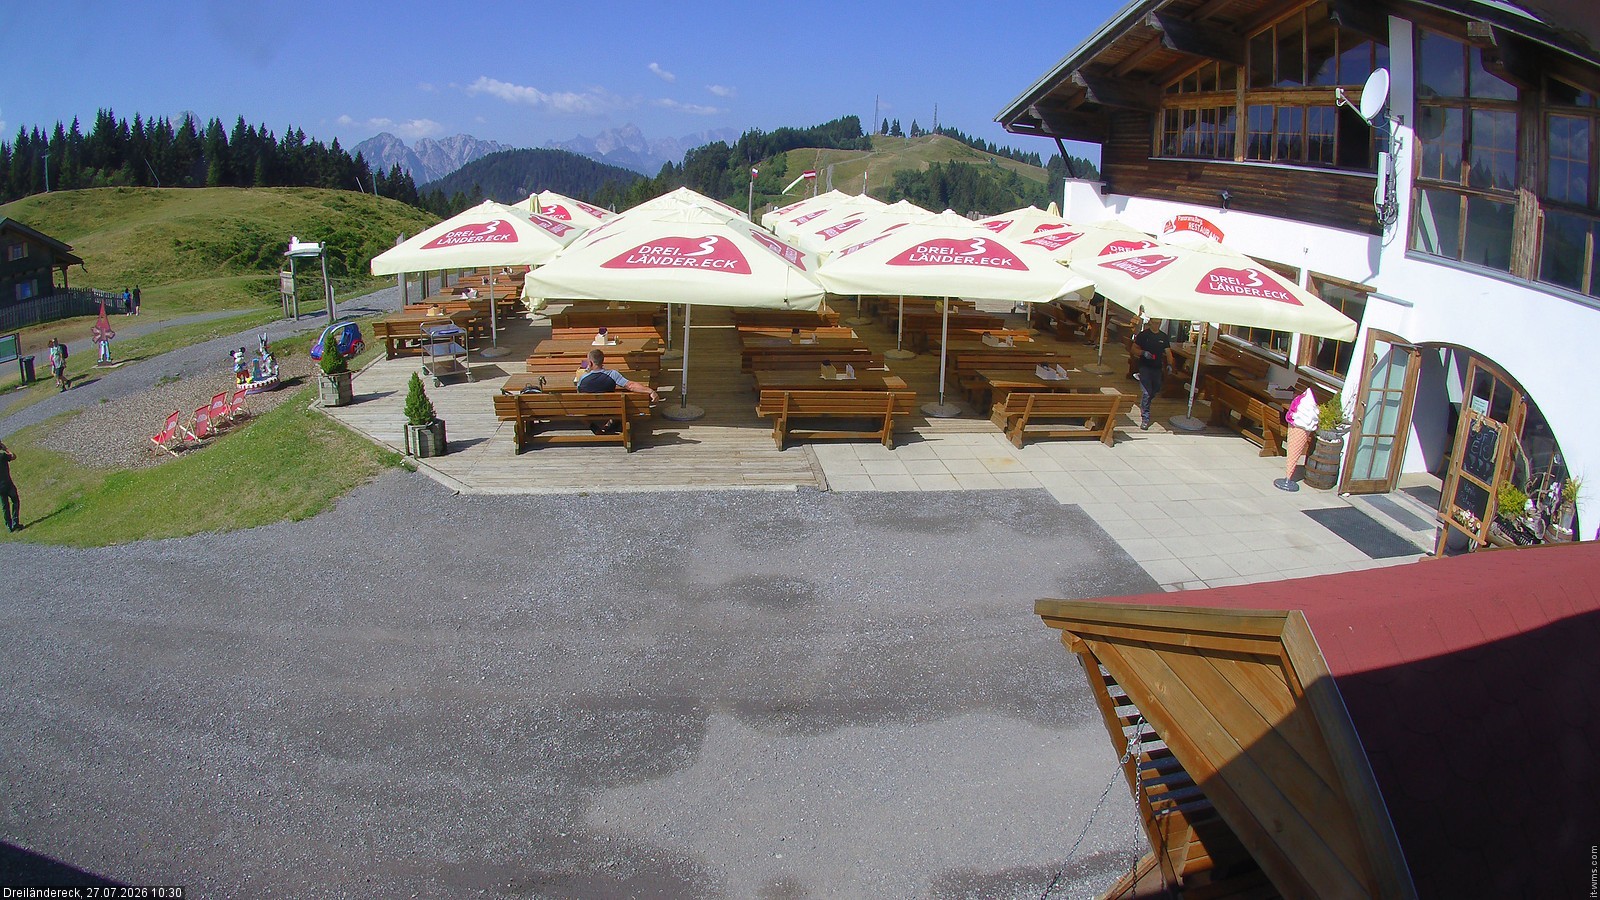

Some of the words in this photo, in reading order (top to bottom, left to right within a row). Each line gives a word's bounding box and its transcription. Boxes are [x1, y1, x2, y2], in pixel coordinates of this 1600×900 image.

[445, 230, 474, 239] DREI.
[1187, 222, 1220, 242] RESTAURANT
[437, 233, 510, 245] LÄNDER.ECK
[638, 245, 682, 256] DREI.
[916, 245, 959, 255] DREI.
[626, 254, 739, 269] LÄNDER.ECK
[908, 253, 1013, 266] LÄNDER.ECK
[1209, 274, 1244, 286] DREI.
[1209, 282, 1289, 300] LÄNDER.ECK
